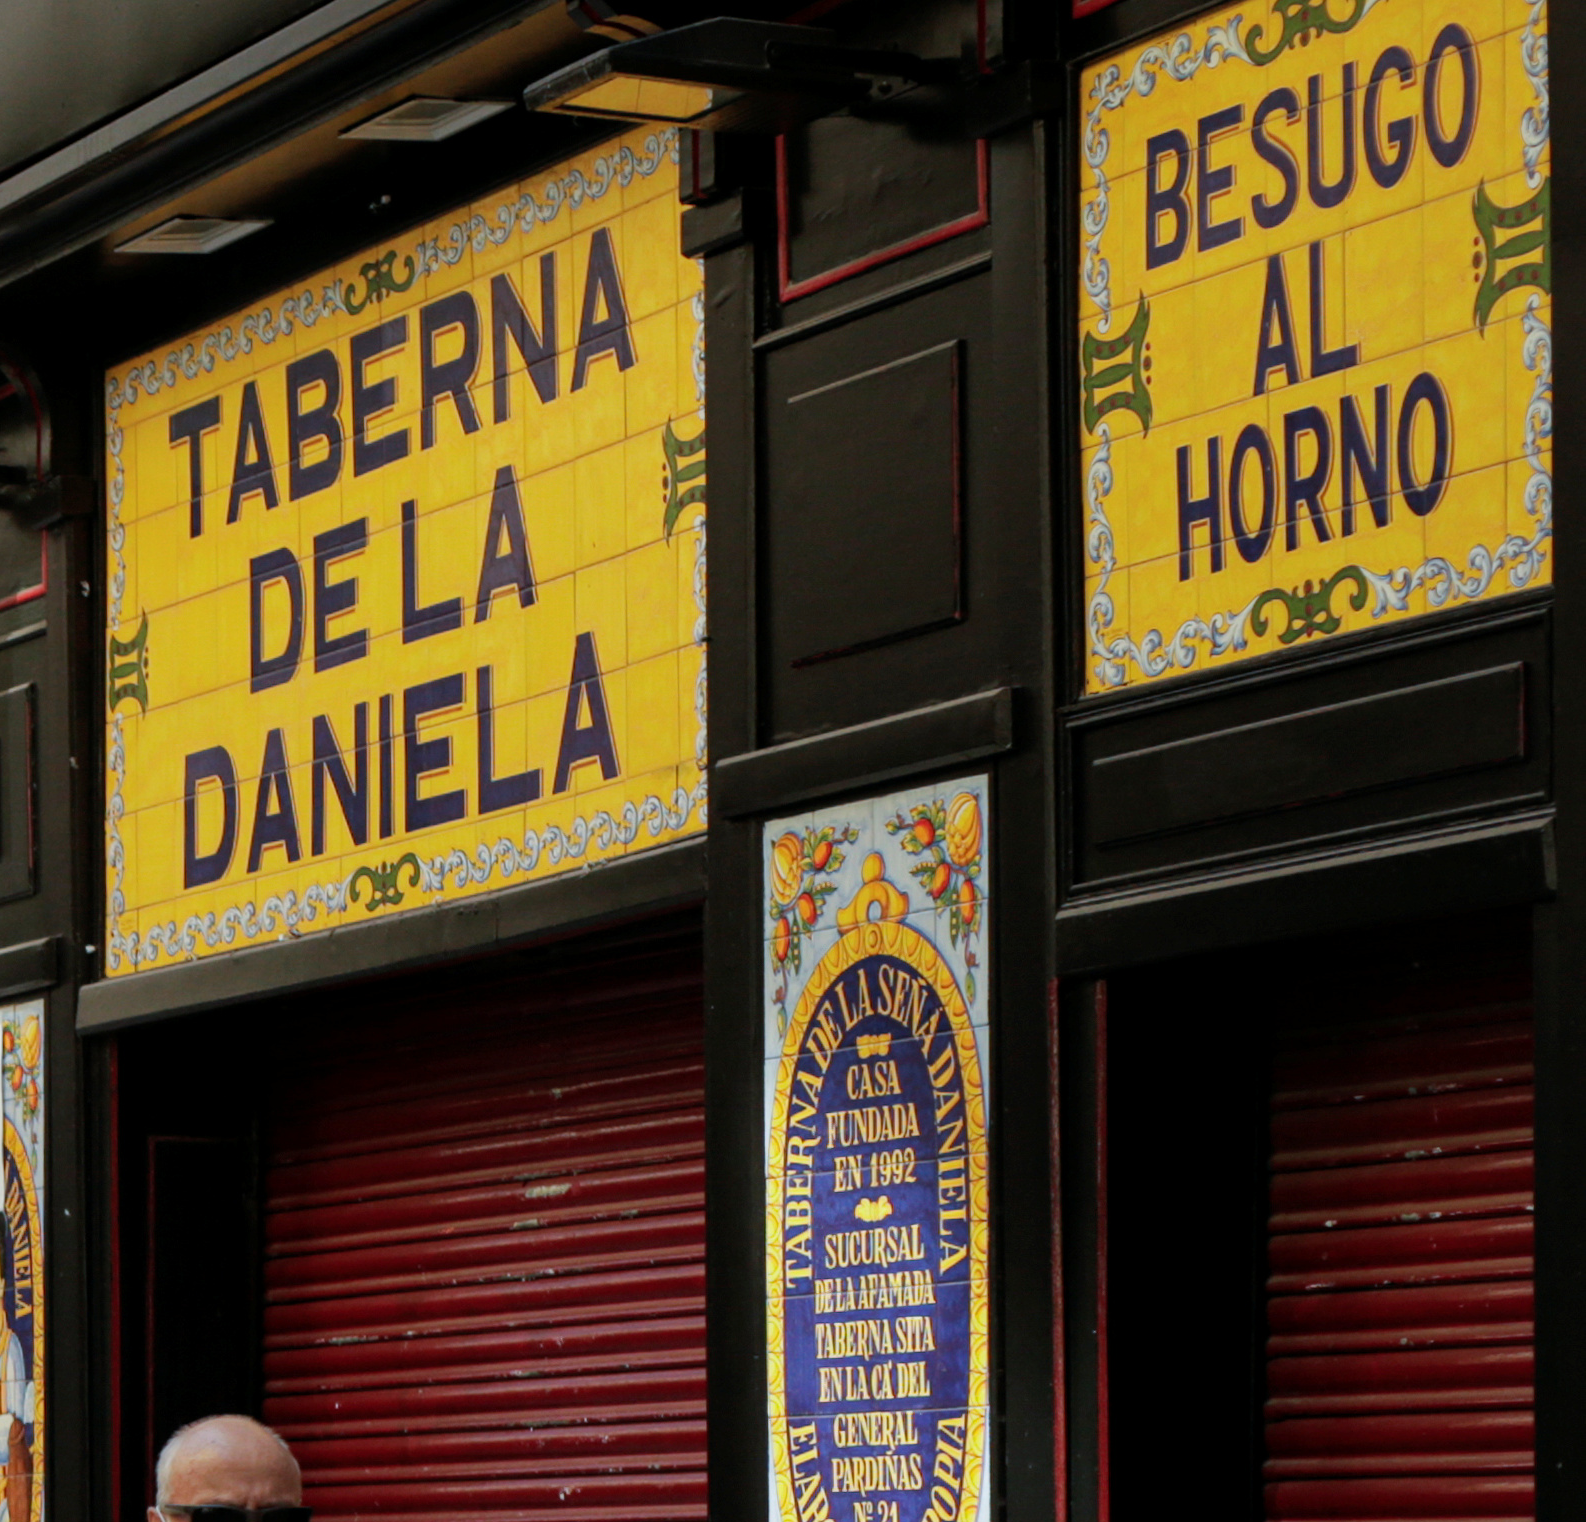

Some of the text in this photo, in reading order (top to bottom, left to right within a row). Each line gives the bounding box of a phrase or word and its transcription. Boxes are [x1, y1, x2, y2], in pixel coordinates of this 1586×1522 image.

[1146, 22, 1481, 271] BESUGO
[1253, 241, 1360, 397] AL
[169, 226, 637, 539] TABERNA
[1176, 371, 1454, 582] HORNO
[250, 464, 537, 694] DE LA
[184, 632, 622, 889] DANIELA
[846, 1060, 902, 1100] CASA
[786, 1069, 824, 1288] TABERNA
[806, 1000, 843, 1074] DE
[835, 968, 874, 1031] LA
[928, 1043, 968, 1276] DANIELA
[826, 1103, 921, 1149] FUNDADA
[833, 1147, 917, 1192] EN 1992
[5, 1177, 32, 1320] DANIELA
[824, 1224, 925, 1269] SUCURSAL
[814, 1268, 937, 1314] DE LA AFAMADA
[815, 1316, 936, 1361] TABERNA SITA
[819, 1366, 842, 1402] EN
[845, 1366, 870, 1401] LA
[896, 1361, 931, 1399] DEL
[833, 1410, 919, 1450] GENERAL
[831, 1449, 923, 1498] PARDIÑAS
